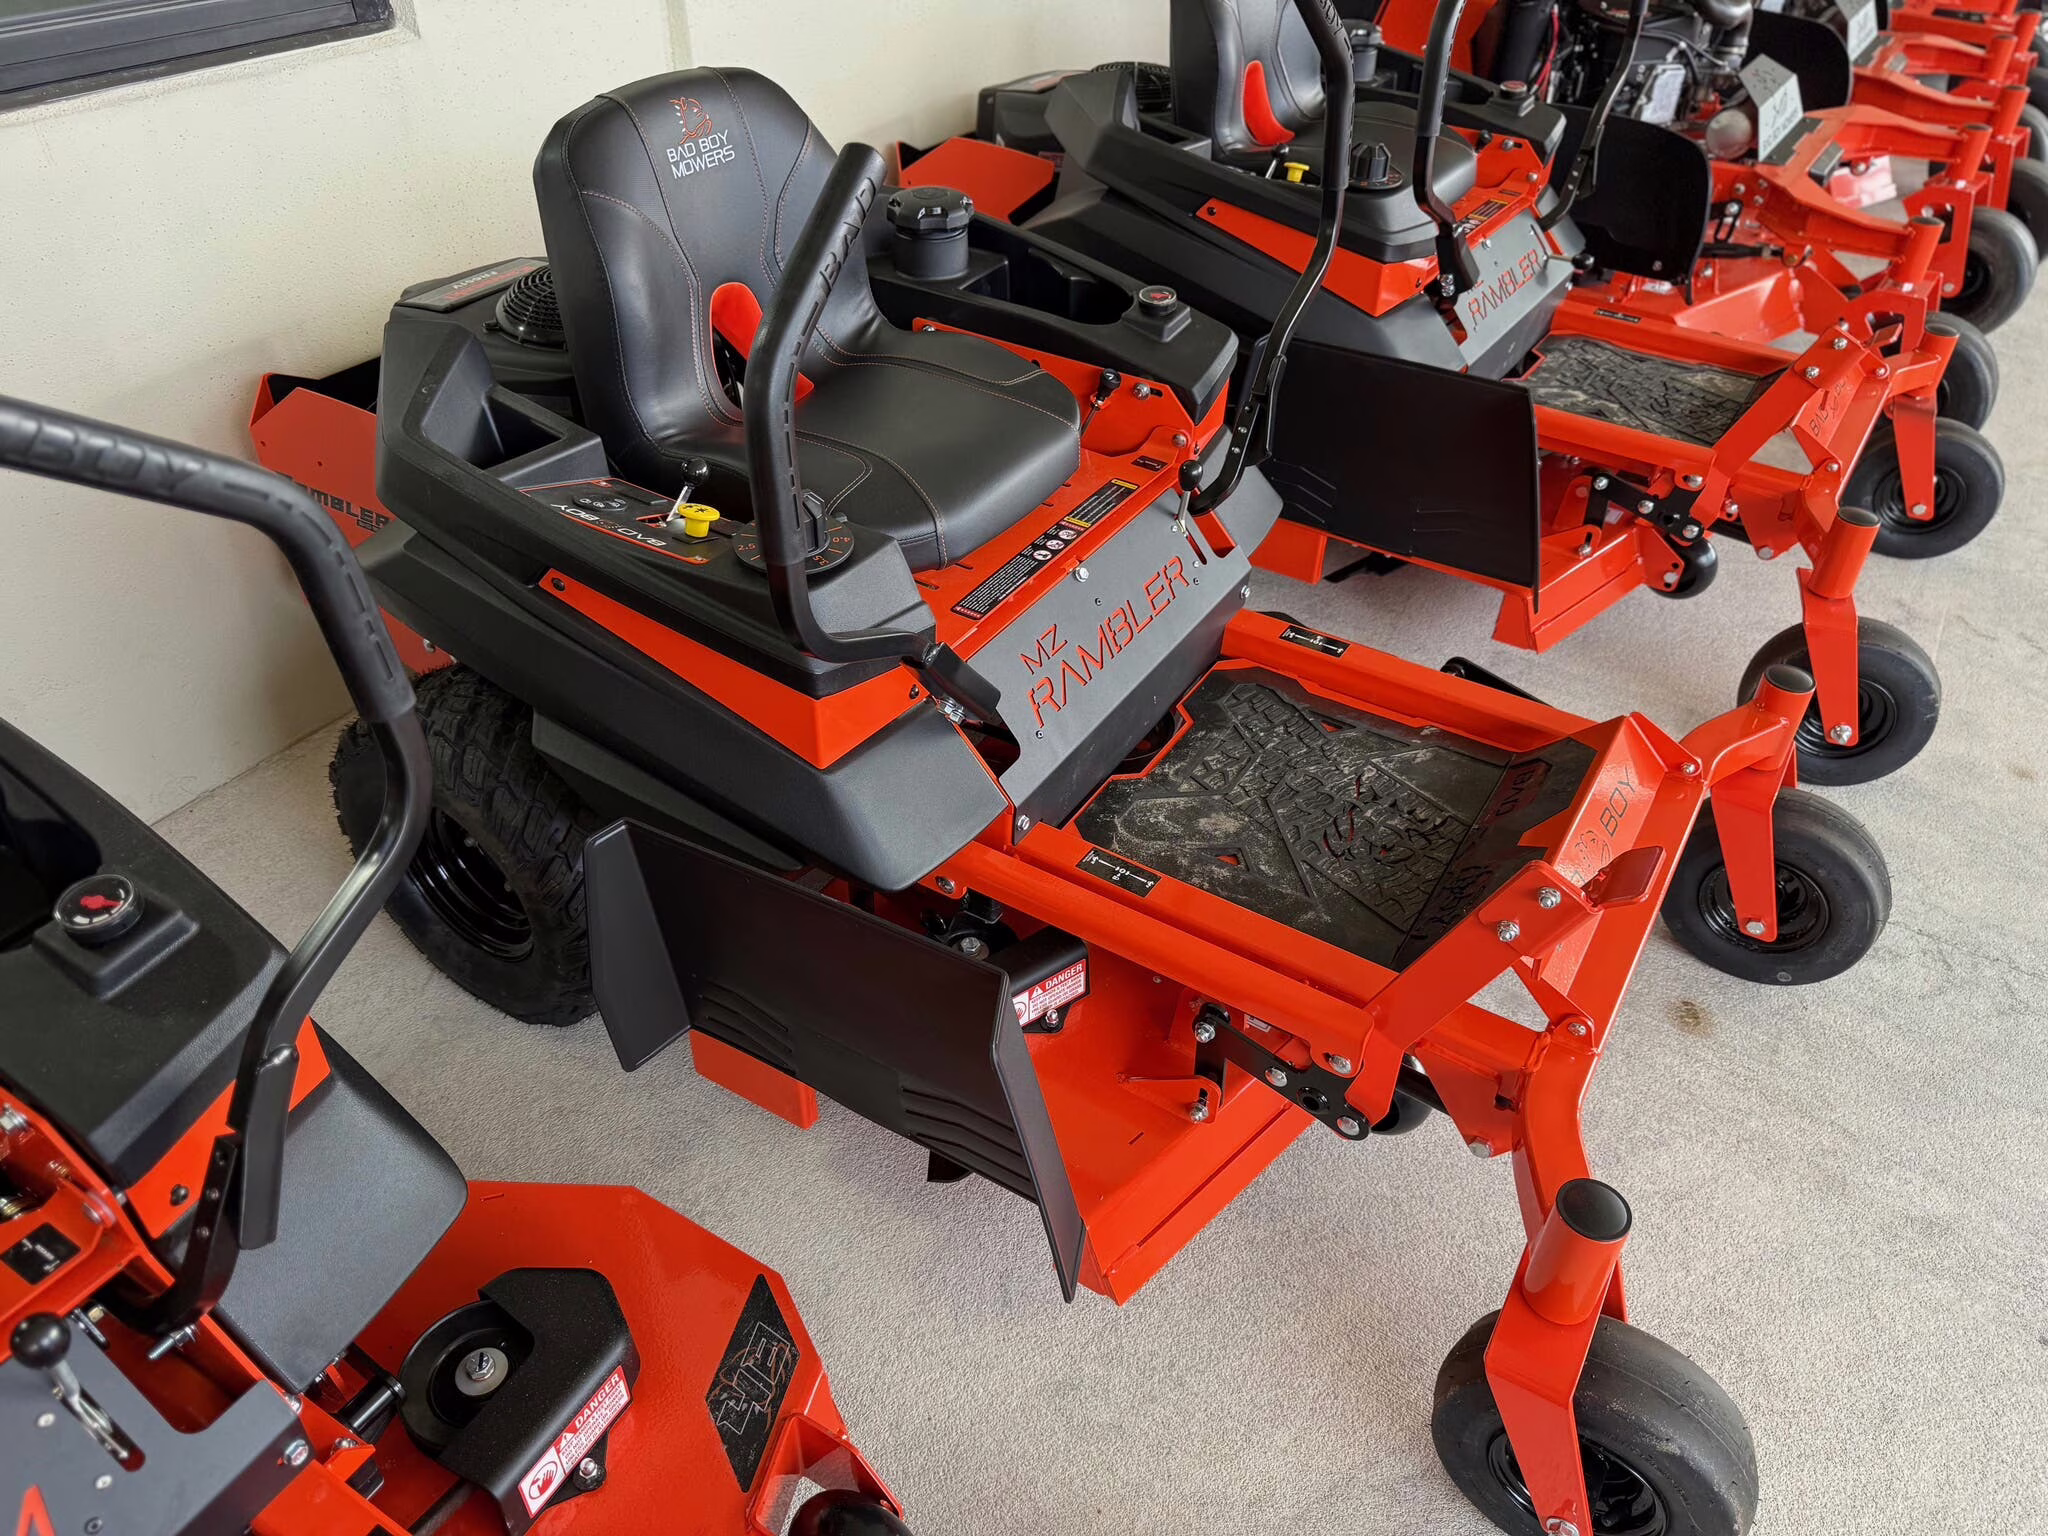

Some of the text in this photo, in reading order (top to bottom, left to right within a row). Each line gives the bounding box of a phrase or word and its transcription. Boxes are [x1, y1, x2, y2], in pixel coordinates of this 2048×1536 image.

[666, 129, 730, 164] BAD BOY
[671, 143, 735, 179] MOWERS
[1466, 248, 1545, 328] RAMBLER
[550, 503, 601, 522] BOY
[615, 526, 669, 547] BAD
[1018, 623, 1070, 675] MZ
[1026, 555, 1190, 729] RAMBLER
[1599, 764, 1637, 838] BOY
[1045, 963, 1083, 990] DANGER
[574, 1373, 620, 1430] DANGER
